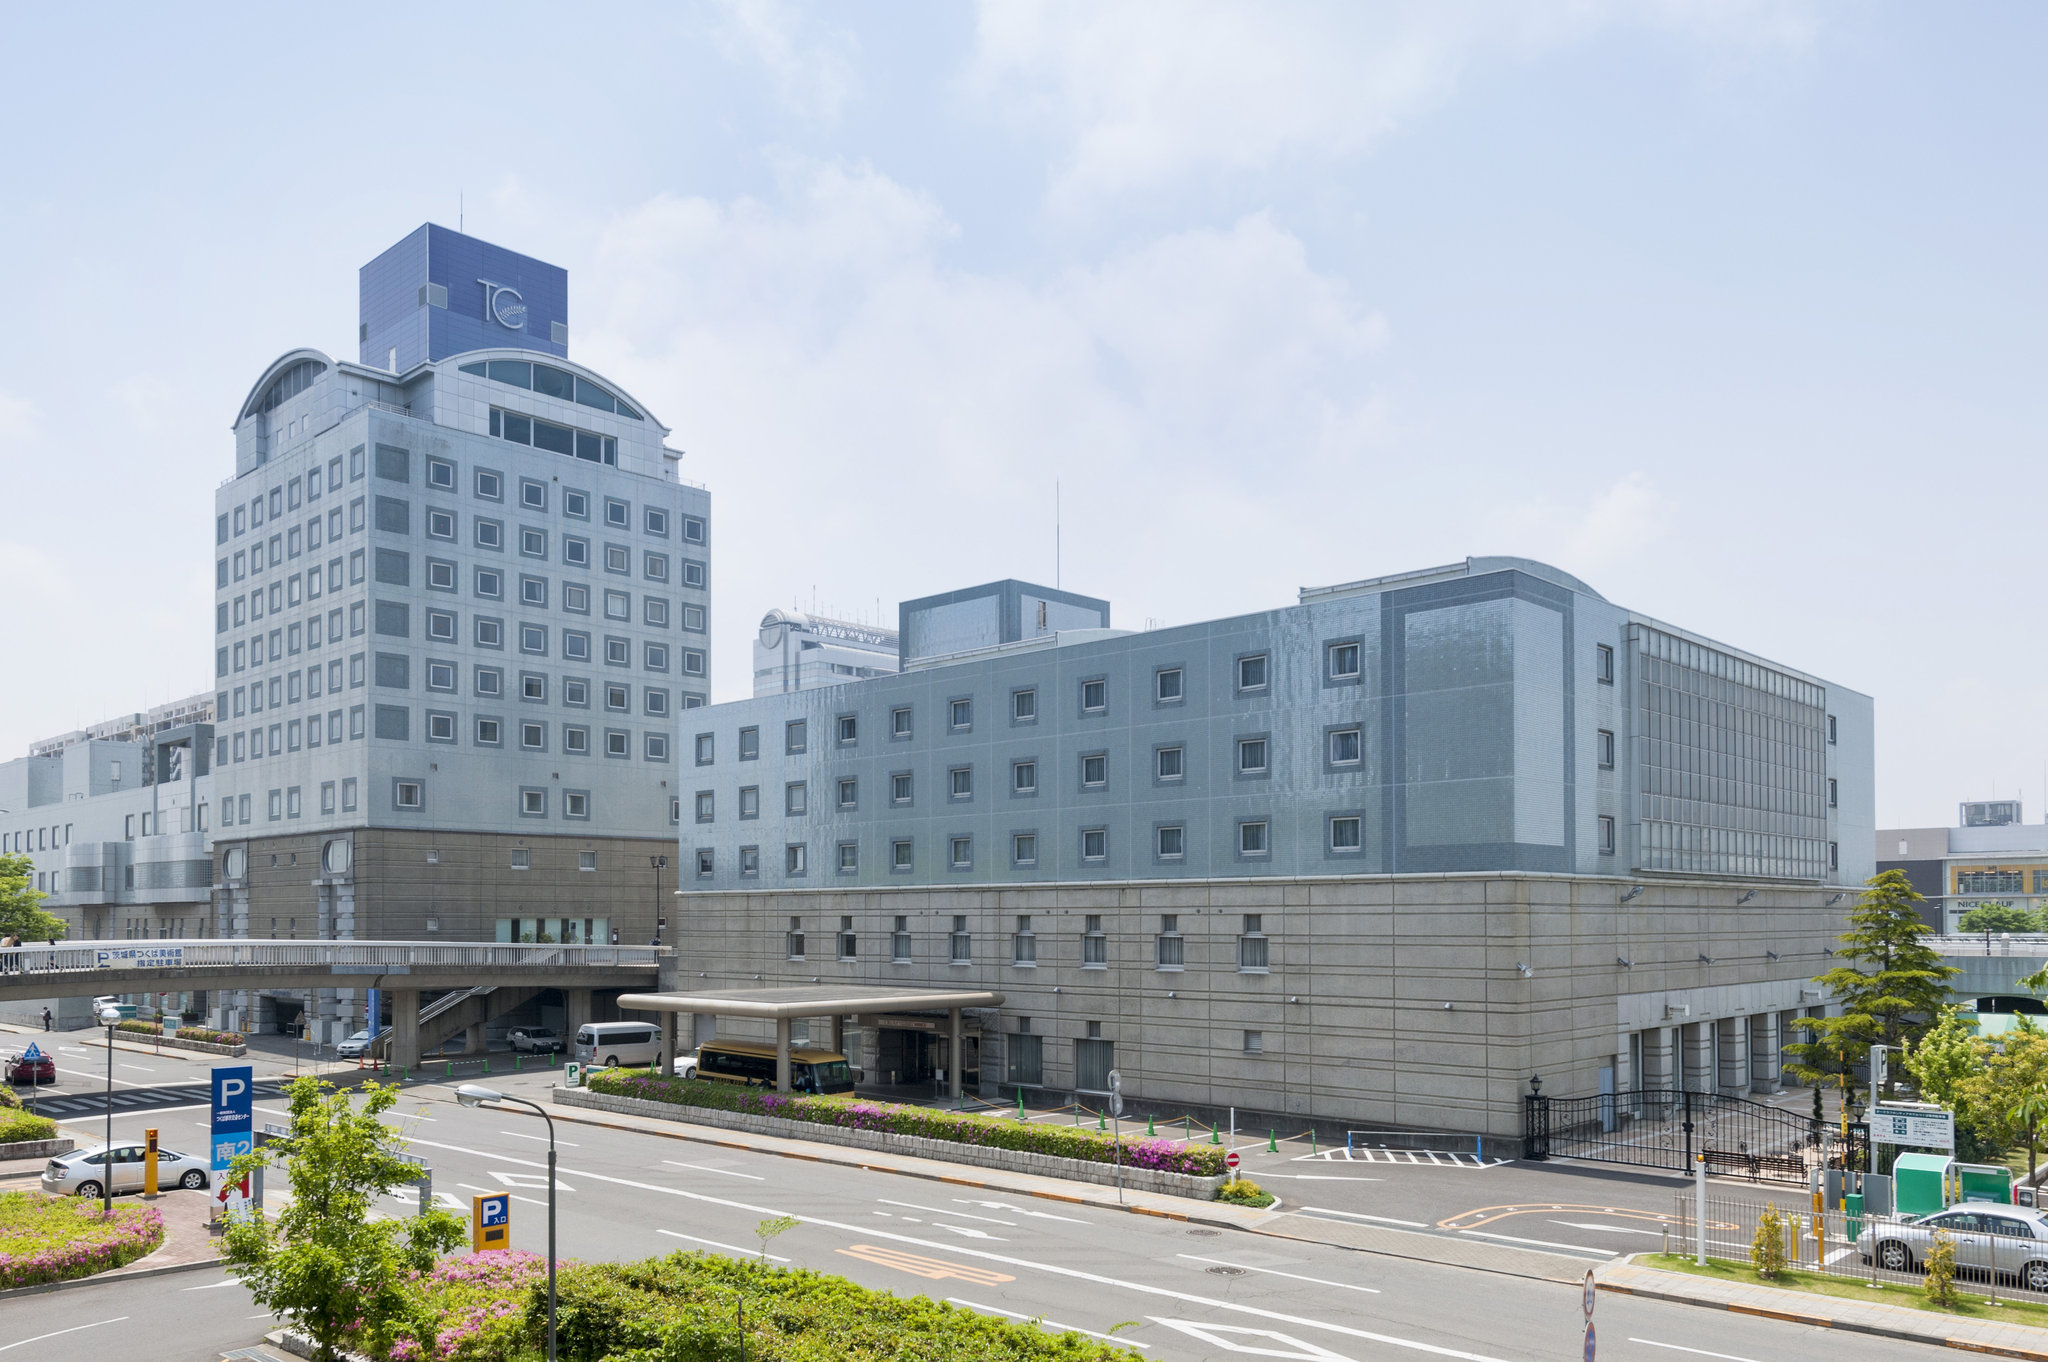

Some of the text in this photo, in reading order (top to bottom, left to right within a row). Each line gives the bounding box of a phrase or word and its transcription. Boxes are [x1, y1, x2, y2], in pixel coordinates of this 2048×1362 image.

[476, 278, 524, 329] TC
[1957, 900, 1980, 908] NICE
[97, 952, 109, 963] P
[112, 948, 183, 959] 茨城県つくば美術館
[136, 959, 182, 967] 指定駐車場
[568, 1065, 579, 1078] P
[221, 1078, 246, 1107] P
[216, 1140, 250, 1162] 南2
[482, 1200, 502, 1225] P
[493, 1216, 507, 1225] 入口
